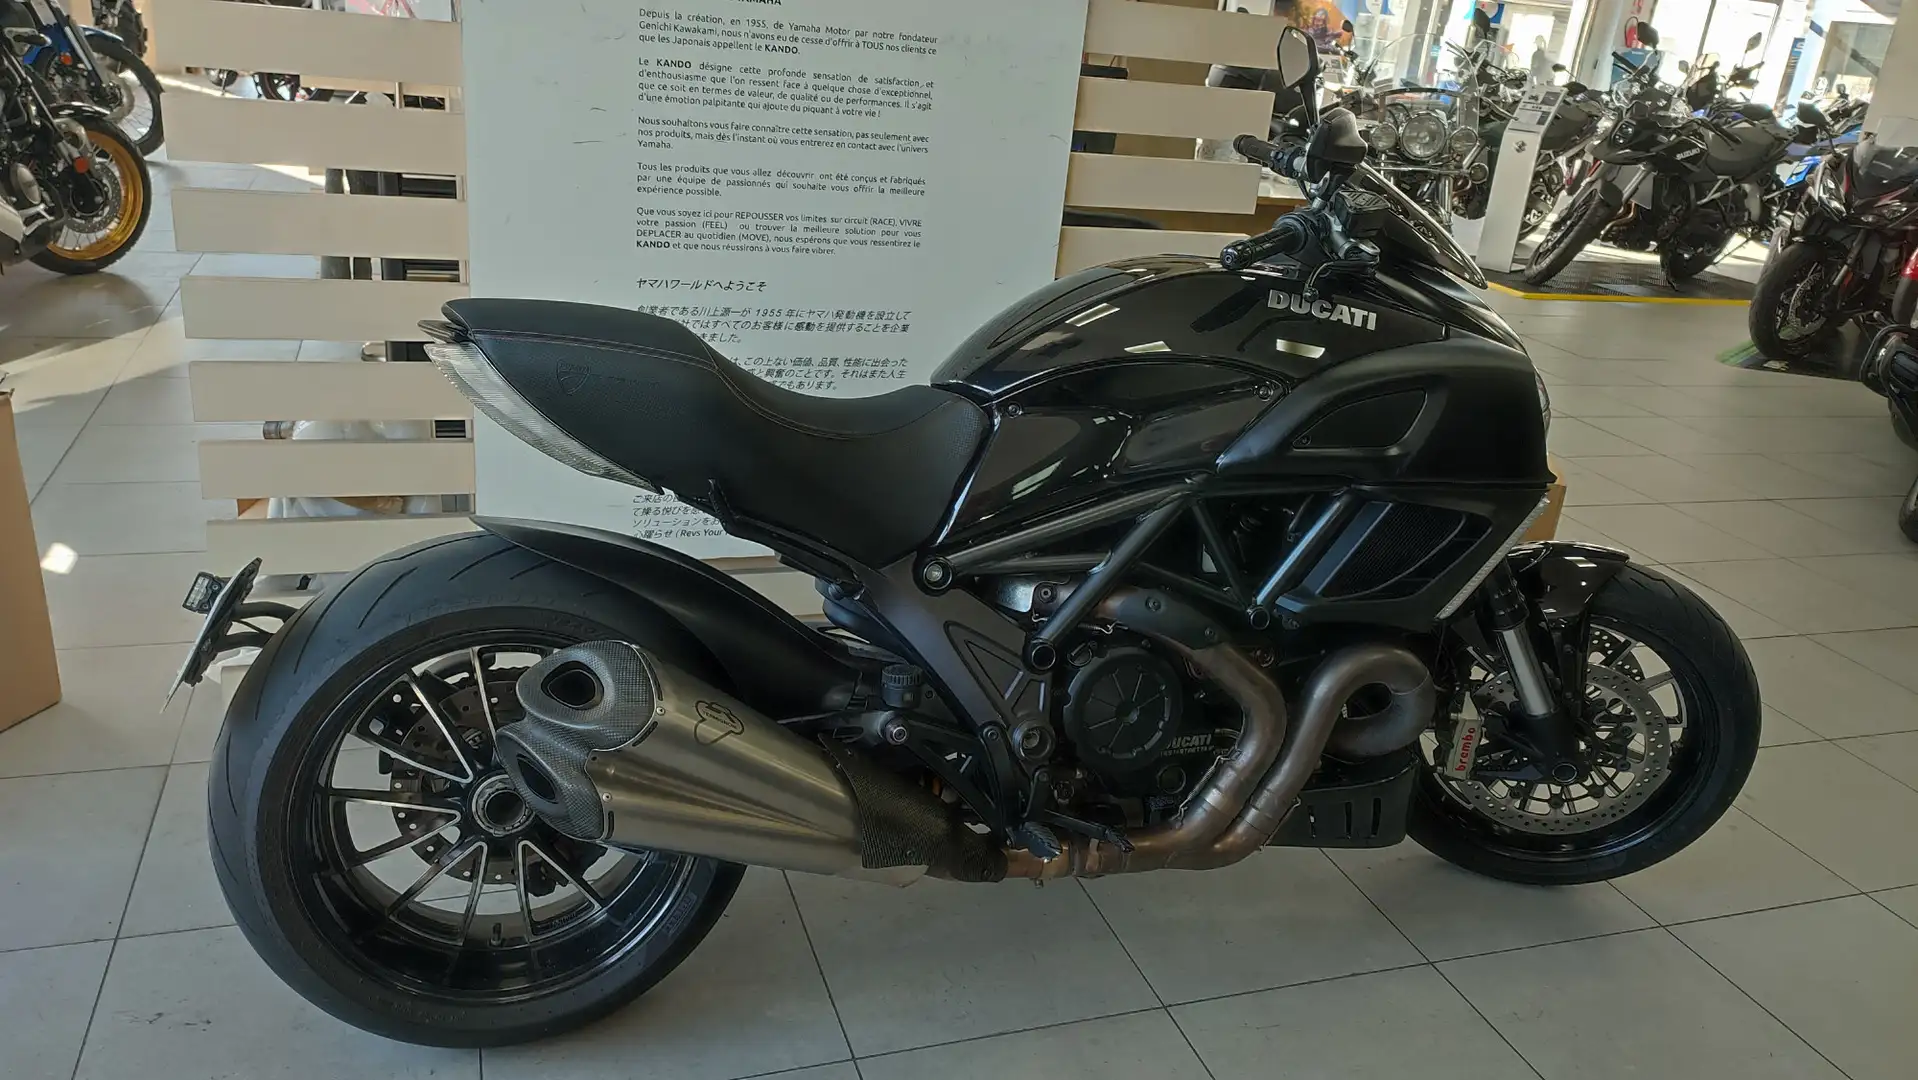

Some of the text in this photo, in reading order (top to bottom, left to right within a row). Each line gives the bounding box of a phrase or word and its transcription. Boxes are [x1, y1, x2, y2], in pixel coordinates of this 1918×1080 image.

[639, 8, 670, 20] Depuis
[674, 11, 682, 20] la
[687, 13, 725, 25] création,
[788, 22, 820, 33] Yamaha
[825, 25, 850, 35] Motor
[854, 30, 868, 38] par
[872, 31, 894, 39] notre
[898, 32, 937, 43] fondateur
[639, 20, 672, 31] Genichi
[673, 23, 719, 36] Kawakami,
[743, 30, 775, 40] n'avons
[801, 37, 823, 45] cesse
[824, 37, 854, 47] d'offrir
[861, 40, 884, 50] TOUS
[900, 44, 926, 54] clients
[638, 35, 655, 43] que
[657, 34, 670, 43] les
[672, 36, 710, 47] Japonais
[712, 40, 752, 50] appellent
[638, 56, 649, 65] Le
[656, 58, 691, 69] KANDO
[699, 61, 732, 73] désigne
[739, 66, 761, 74] cette
[768, 68, 806, 78] profonde
[812, 72, 851, 81] sensation
[638, 68, 707, 81] d'enthousiasme
[710, 76, 727, 84] que
[729, 75, 745, 84] l'on
[748, 79, 780, 87] ressent
[782, 79, 800, 89] face
[811, 83, 844, 94] quelque
[847, 85, 871, 94] chose
[638, 83, 654, 91] que
[670, 83, 686, 92] soit
[702, 86, 732, 95] termes
[747, 89, 774, 99] valeur,
[789, 92, 818, 102] qualité
[911, 101, 931, 111] s'agit
[638, 92, 876, 117] d'une émotion palpitante qui ajoute piquant votre vie
[638, 115, 660, 125] Nous
[661, 118, 708, 128] souhaitons
[730, 121, 750, 131] faire
[751, 124, 790, 133] connaître
[791, 127, 812, 135] cette
[813, 128, 854, 139] sensation,
[855, 132, 869, 140] pas
[870, 131, 911, 141] seulement
[655, 129, 693, 139] produits,
[694, 131, 714, 140] mais
[716, 132, 731, 141] dès
[732, 133, 766, 143] l'instant
[800, 139, 834, 147] entrerez
[847, 142, 877, 150] contact
[896, 143, 928, 153] l'univers
[637, 161, 657, 170] Tous
[659, 163, 672, 171] les
[674, 164, 710, 174] produits
[712, 168, 728, 176] que
[752, 168, 771, 177] allez
[776, 169, 814, 179] découvrir
[835, 172, 848, 181] été
[850, 175, 877, 184] conçus
[889, 175, 925, 186] fabriqués
[637, 175, 651, 183] par
[677, 175, 706, 186] équipe
[726, 178, 770, 188] passionnés
[775, 180, 788, 190] qui
[792, 181, 826, 190] souhaite
[853, 184, 874, 193] offrir
[889, 186, 925, 195] meilleure
[636, 185, 721, 197] expérience possible.
[636, 206, 654, 215] Que
[677, 210, 701, 219] soyez
[702, 209, 713, 217] ici
[713, 212, 733, 220] pour
[735, 211, 784, 220] REPOUSSER
[800, 213, 827, 222] limites
[844, 215, 868, 224] circuit
[899, 217, 921, 226] VIVRE
[636, 228, 682, 238] DEPLACER
[696, 231, 735, 241] quotidien
[795, 235, 831, 245] espérons
[832, 238, 847, 246] que
[870, 238, 911, 247] ressentirez
[664, 219, 696, 229] passion
[702, 220, 728, 231] (FEEL)
[755, 223, 785, 231] trouver
[803, 224, 839, 234] meilleure
[844, 226, 876, 235] solution
[881, 230, 899, 238] pour
[636, 239, 670, 248] KANDO
[683, 243, 698, 251] que
[722, 242, 763, 252] réussirons
[791, 245, 810, 253] faire
[637, 278, 767, 292] ヤマハワールドへようこそ
[755, 308, 783, 318] 1955
[785, 309, 912, 321] 年にヤマハ発動機を設立して
[1267, 289, 1377, 331] DUCATI
[675, 529, 701, 538] (Revs
[703, 528, 723, 536] Your
[1455, 727, 1476, 771] brembo
